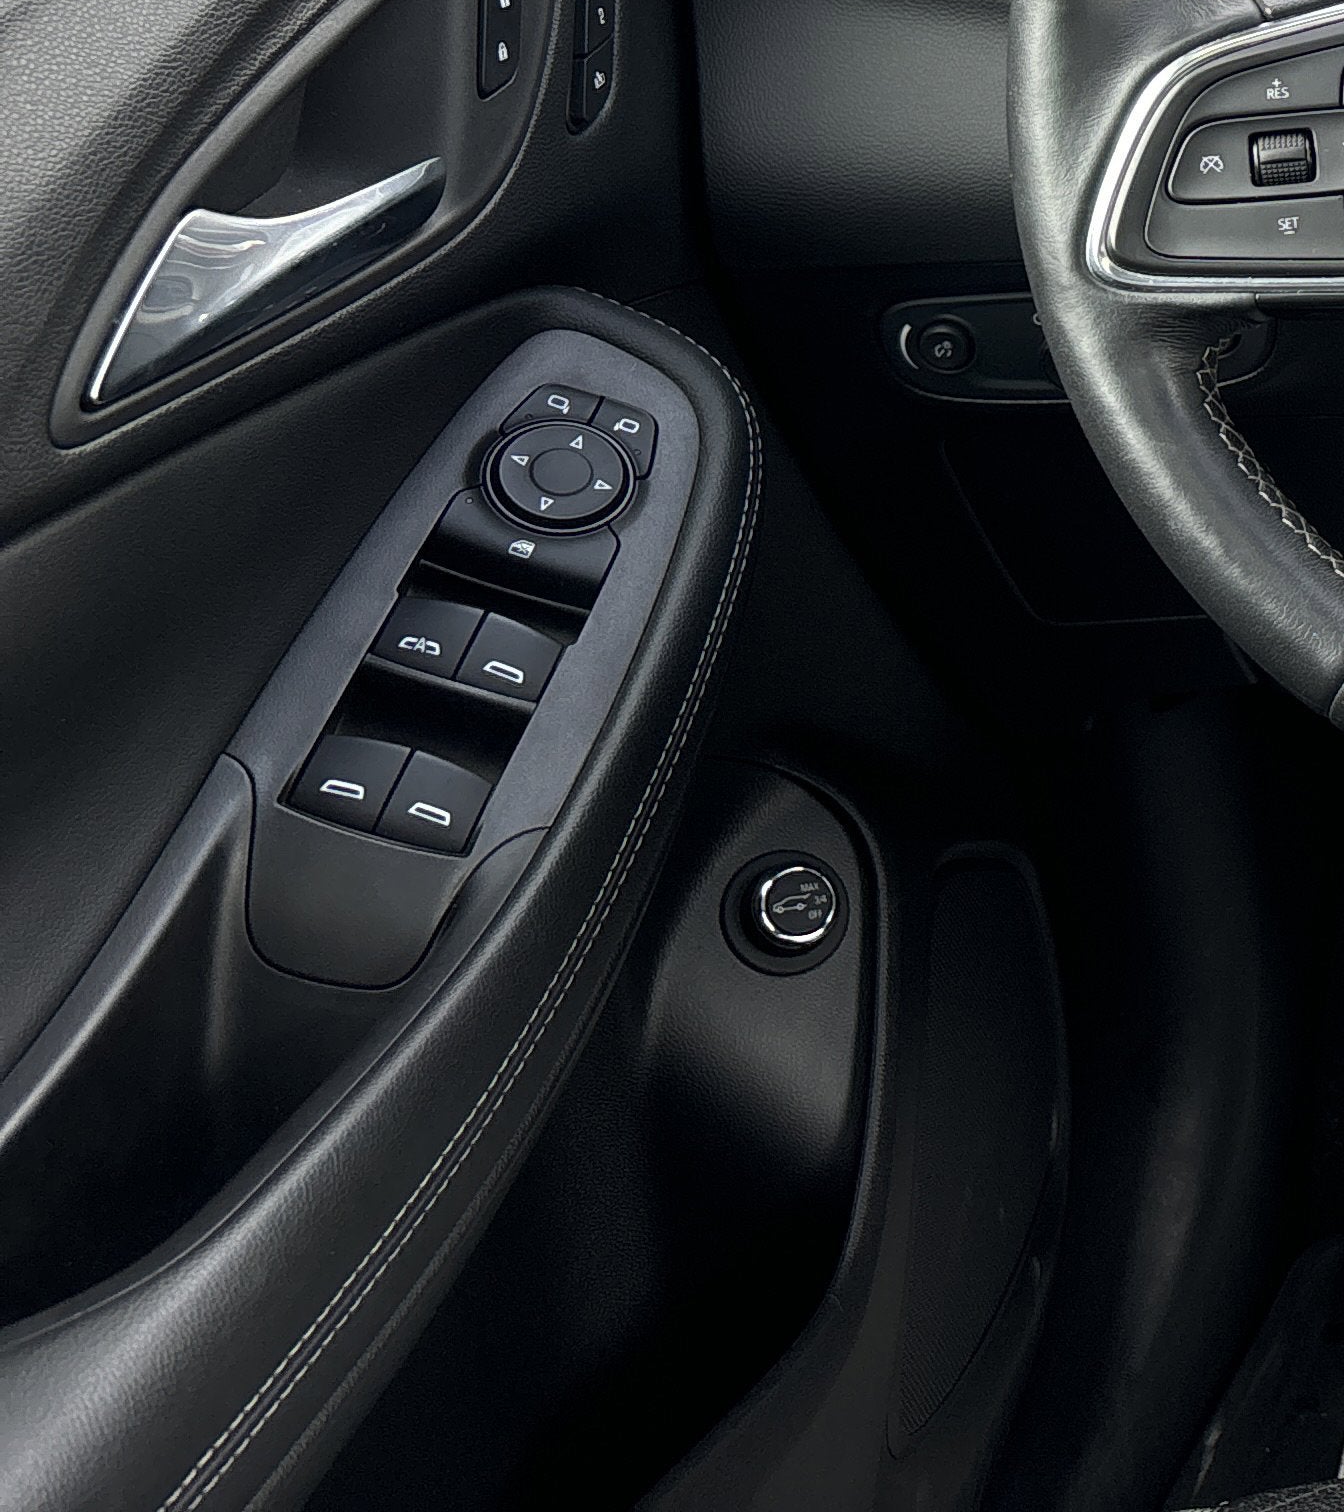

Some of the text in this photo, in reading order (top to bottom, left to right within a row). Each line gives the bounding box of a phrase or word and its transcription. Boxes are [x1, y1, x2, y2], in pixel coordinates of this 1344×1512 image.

[597, 7, 606, 25] 2
[1266, 85, 1290, 100] RES
[1277, 217, 1299, 232] SET
